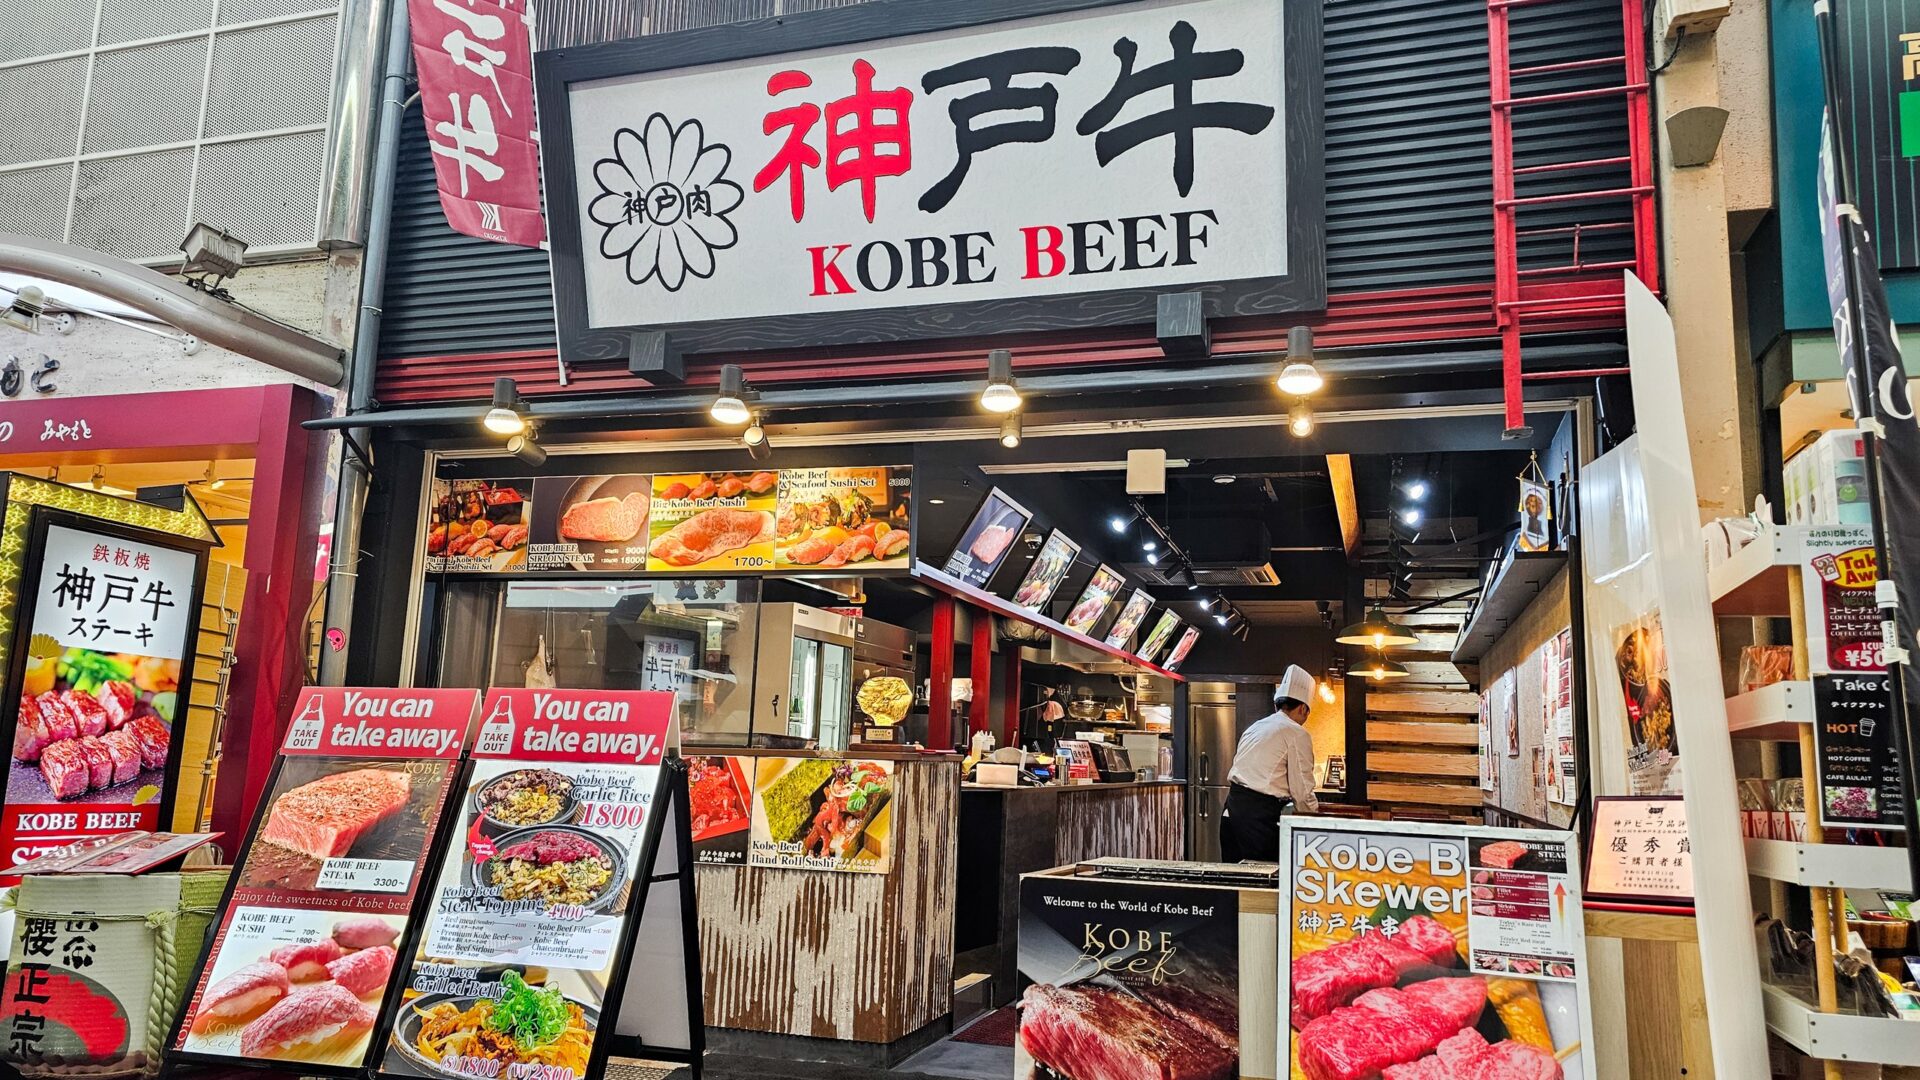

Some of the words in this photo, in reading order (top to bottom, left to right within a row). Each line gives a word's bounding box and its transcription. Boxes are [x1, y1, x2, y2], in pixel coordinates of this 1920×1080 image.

[753, 20, 1275, 225] 神戸牛
[621, 185, 713, 225] 神戸肉
[806, 230, 998, 297] KOBE
[1020, 209, 1221, 281] BEEF
[40, 419, 92, 441] みやもと
[779, 470, 805, 480] Kobe
[808, 470, 829, 479] Beef
[791, 478, 828, 488] Seafood
[830, 477, 856, 488] Sushi
[859, 477, 876, 486] Set
[671, 498, 694, 508] Kobe
[695, 498, 717, 508] Beef
[719, 497, 746, 507] Sushi
[529, 543, 554, 553] KOBE
[554, 543, 578, 553] BEEF
[1806, 539, 1834, 547] Slightly
[92, 543, 151, 571] 鉄板焼
[528, 553, 564, 564] SIRLOIN
[564, 553, 595, 563] STEAK
[481, 563, 493, 571] Set
[1845, 570, 1877, 585] Aw
[52, 563, 175, 622] 神戸牛
[67, 616, 154, 648] ステーキ
[1832, 679, 1878, 692] Take
[343, 691, 388, 717] You
[390, 698, 434, 718] can
[533, 693, 582, 721] You
[583, 700, 630, 722] can
[294, 729, 319, 738] TAKE
[1826, 723, 1858, 734] HOT
[293, 738, 314, 747] OUT
[331, 720, 385, 748] take
[387, 728, 460, 756] away.
[483, 732, 509, 743] TAKE
[523, 723, 580, 753] take
[582, 732, 660, 763] away.
[483, 742, 505, 752] OUT
[403, 760, 441, 775] KOBE
[574, 774, 605, 787] Kobe
[607, 775, 636, 789] Beef
[571, 787, 616, 802] Garlic
[618, 788, 652, 803] Rice
[16, 813, 78, 831] KOBE
[85, 812, 142, 830] BEEF
[579, 802, 645, 829] 1800
[752, 840, 778, 851] Kobe
[780, 842, 803, 852] Beef
[1520, 842, 1543, 851] KOBE
[1610, 836, 1691, 854] 優秀賞
[751, 853, 778, 865] Hand
[780, 854, 803, 866] Roll
[804, 856, 836, 868] Sushi
[1296, 833, 1415, 874] Kobe
[1429, 841, 1469, 877] B
[326, 860, 354, 869] KOBE
[355, 861, 382, 871] BEEF
[322, 870, 356, 880] STEAK
[442, 886, 474, 899] Kobe
[475, 885, 504, 898] Beef
[232, 890, 263, 905] Enjoy
[265, 892, 283, 903] the
[286, 895, 338, 906] sweetness
[341, 896, 354, 907] of
[356, 898, 384, 909] Kobe
[387, 899, 412, 911] beef
[438, 898, 479, 914] Steak
[483, 898, 546, 917] Topping
[1043, 895, 1085, 908] Welcome
[1087, 899, 1098, 908] to
[1100, 898, 1116, 910] the
[1118, 900, 1148, 912] World
[1150, 901, 1162, 913] of
[1163, 903, 1189, 915] Kobe
[1191, 905, 1214, 917] Beef
[240, 912, 268, 923] KOBE
[268, 914, 296, 924] BEEF
[1297, 909, 1400, 941] 神戸牛串
[235, 923, 266, 934] SUSHI
[537, 923, 556, 931] Kobe
[556, 924, 573, 933] Beef
[473, 931, 492, 940] Kobe
[492, 932, 509, 941] Beef
[533, 937, 553, 945] Kobe
[553, 937, 570, 946] Beef
[1084, 922, 1174, 953] KOBE
[455, 943, 471, 952] Beef
[417, 963, 451, 979] Kobe
[450, 965, 481, 979] Beef
[1059, 940, 1187, 987] Beef
[9, 911, 58, 1060] 櫻正宗
[173, 1006, 196, 1051] KOBE
[192, 966, 212, 1003] BEEF
[207, 928, 228, 962] Sushi
[413, 976, 468, 997] Grilled
